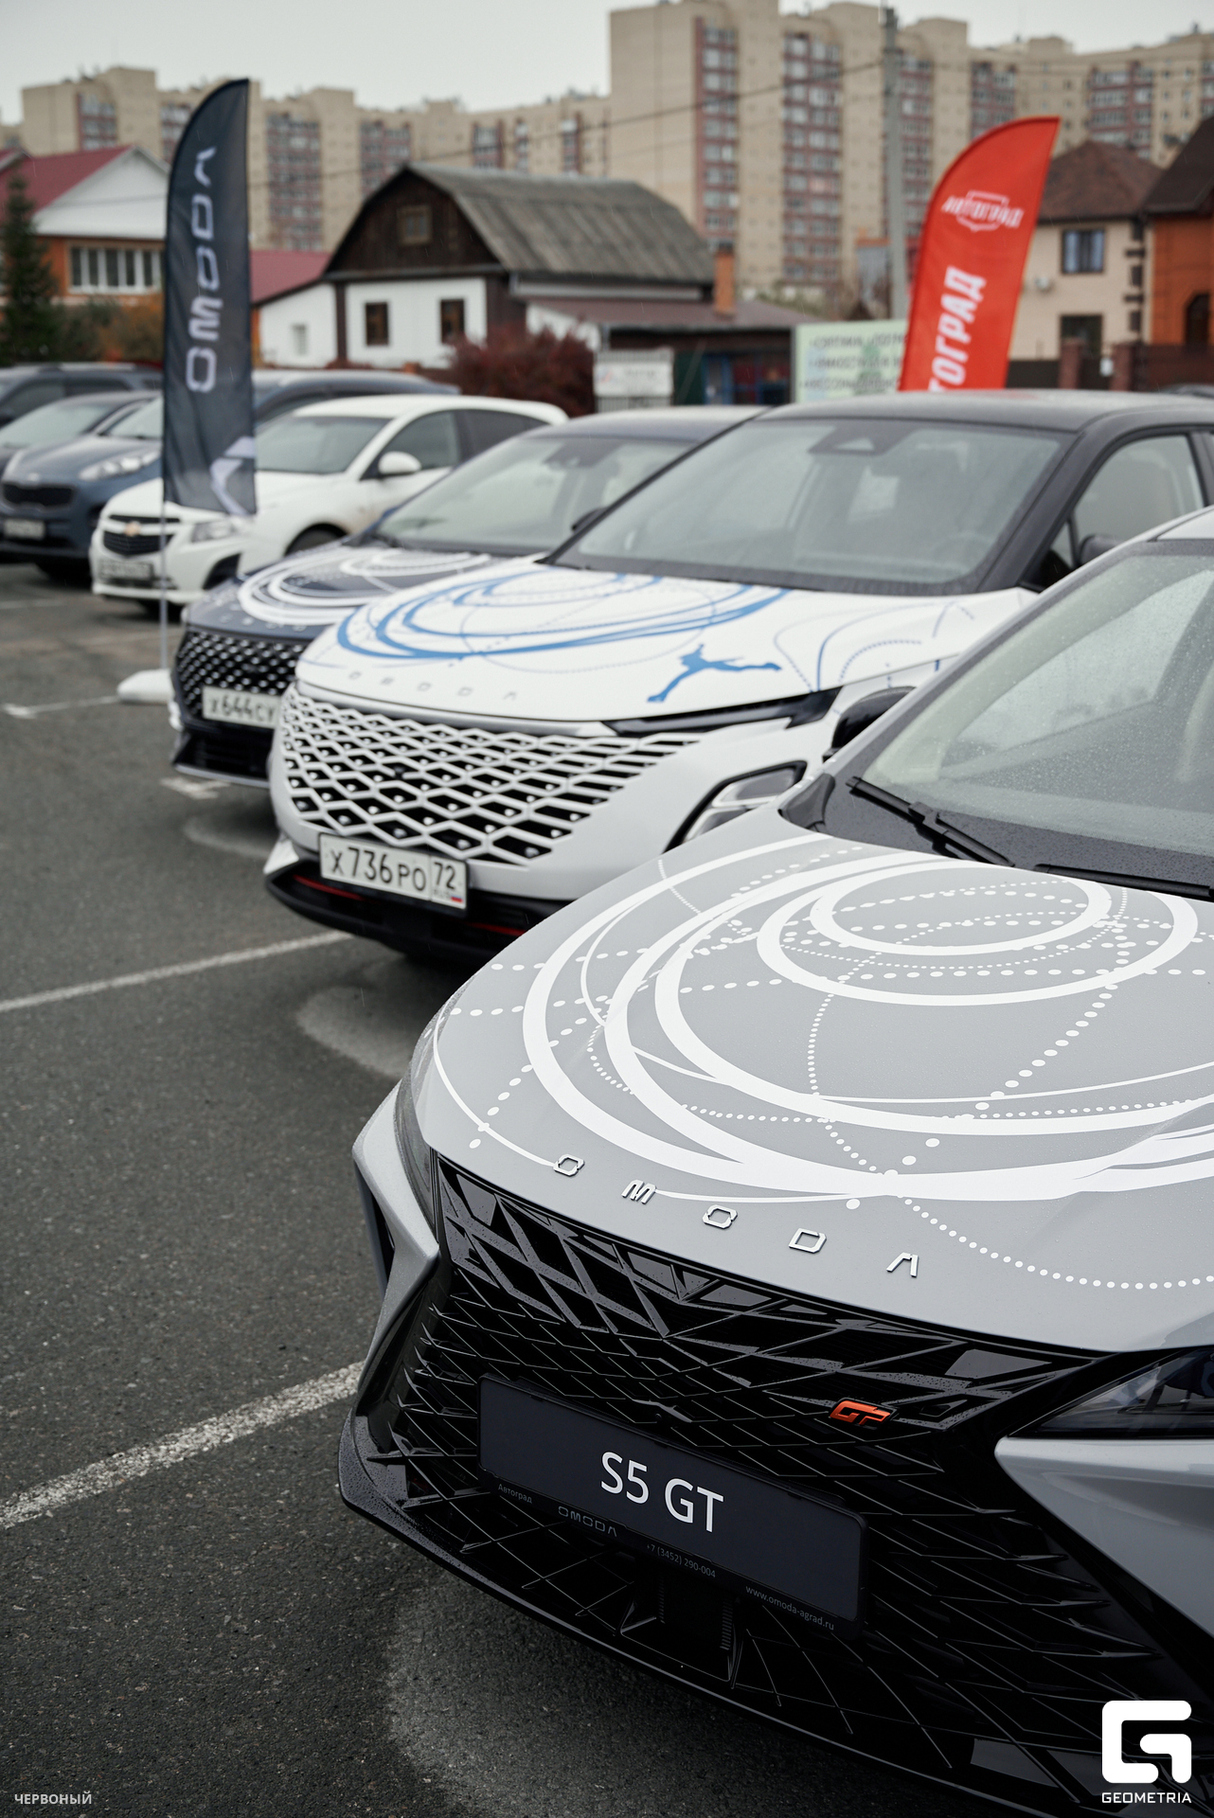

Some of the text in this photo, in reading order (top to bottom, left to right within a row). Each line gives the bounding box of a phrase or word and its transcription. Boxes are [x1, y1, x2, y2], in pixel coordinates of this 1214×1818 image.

[185, 146, 224, 394] OMODA
[552, 1152, 922, 1279] OMODA
[829, 1399, 892, 1426] GT
[497, 1482, 534, 1506] Автоград
[600, 1450, 725, 1534] S5 GT
[557, 1504, 618, 1538] OMODA
[656, 1545, 683, 1567] (3452)
[684, 1558, 717, 1579] 290-004
[745, 1585, 835, 1632] www.omoda-agrad.ru
